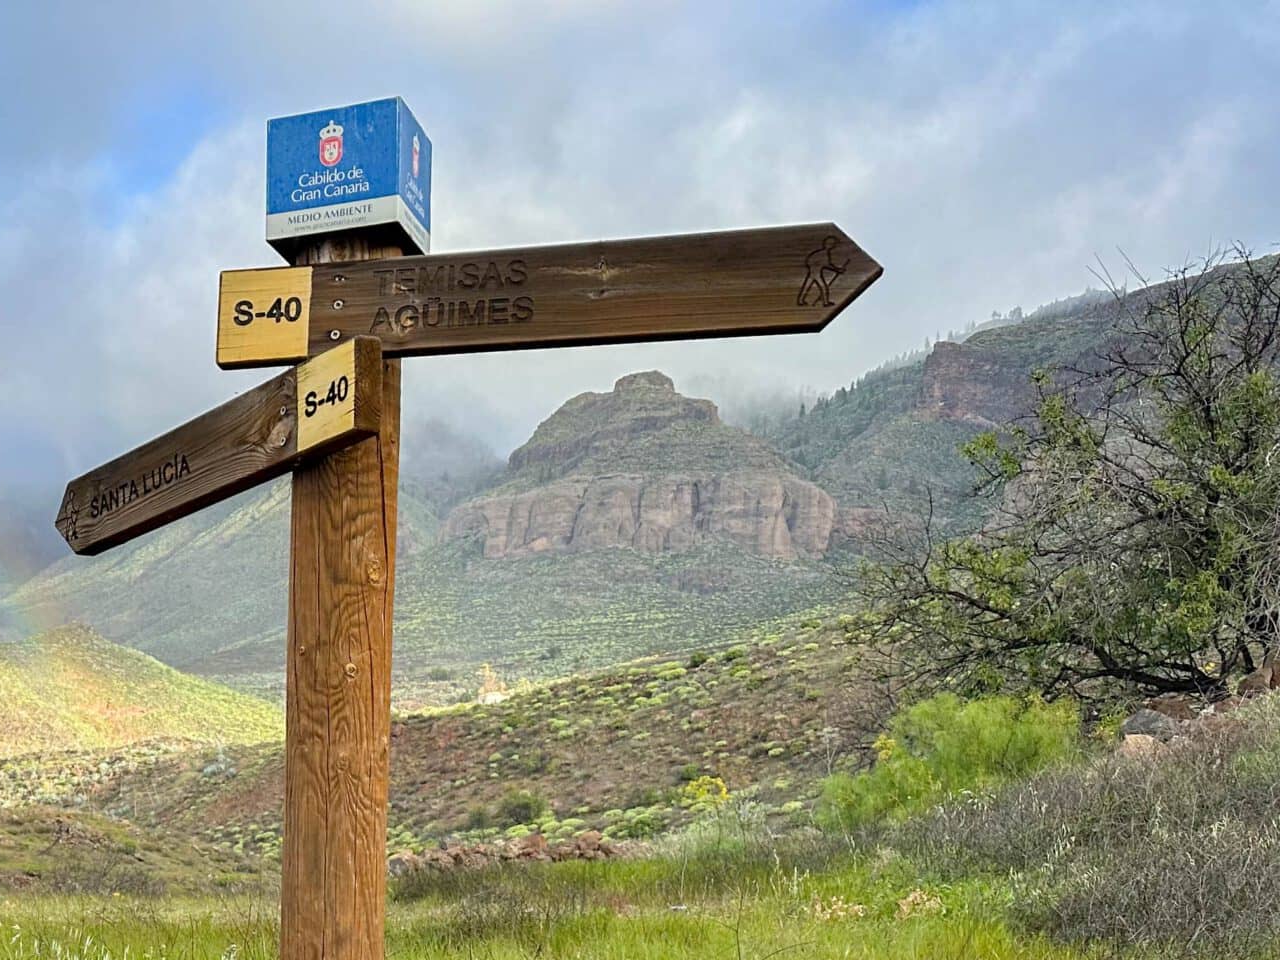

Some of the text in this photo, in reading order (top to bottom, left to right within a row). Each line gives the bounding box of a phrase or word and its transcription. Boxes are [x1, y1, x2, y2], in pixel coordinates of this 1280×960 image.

[291, 180, 370, 202] Gran Canaria
[299, 165, 363, 187] Cabildo de
[288, 212, 321, 225] MEDIO
[324, 204, 373, 219] AMBIENTE
[373, 260, 528, 297] TEMISAS
[233, 297, 302, 326] S-40
[370, 296, 534, 333] AGÜIMES
[304, 375, 349, 418] S-40
[90, 452, 191, 519] SANTA LUCÍA
